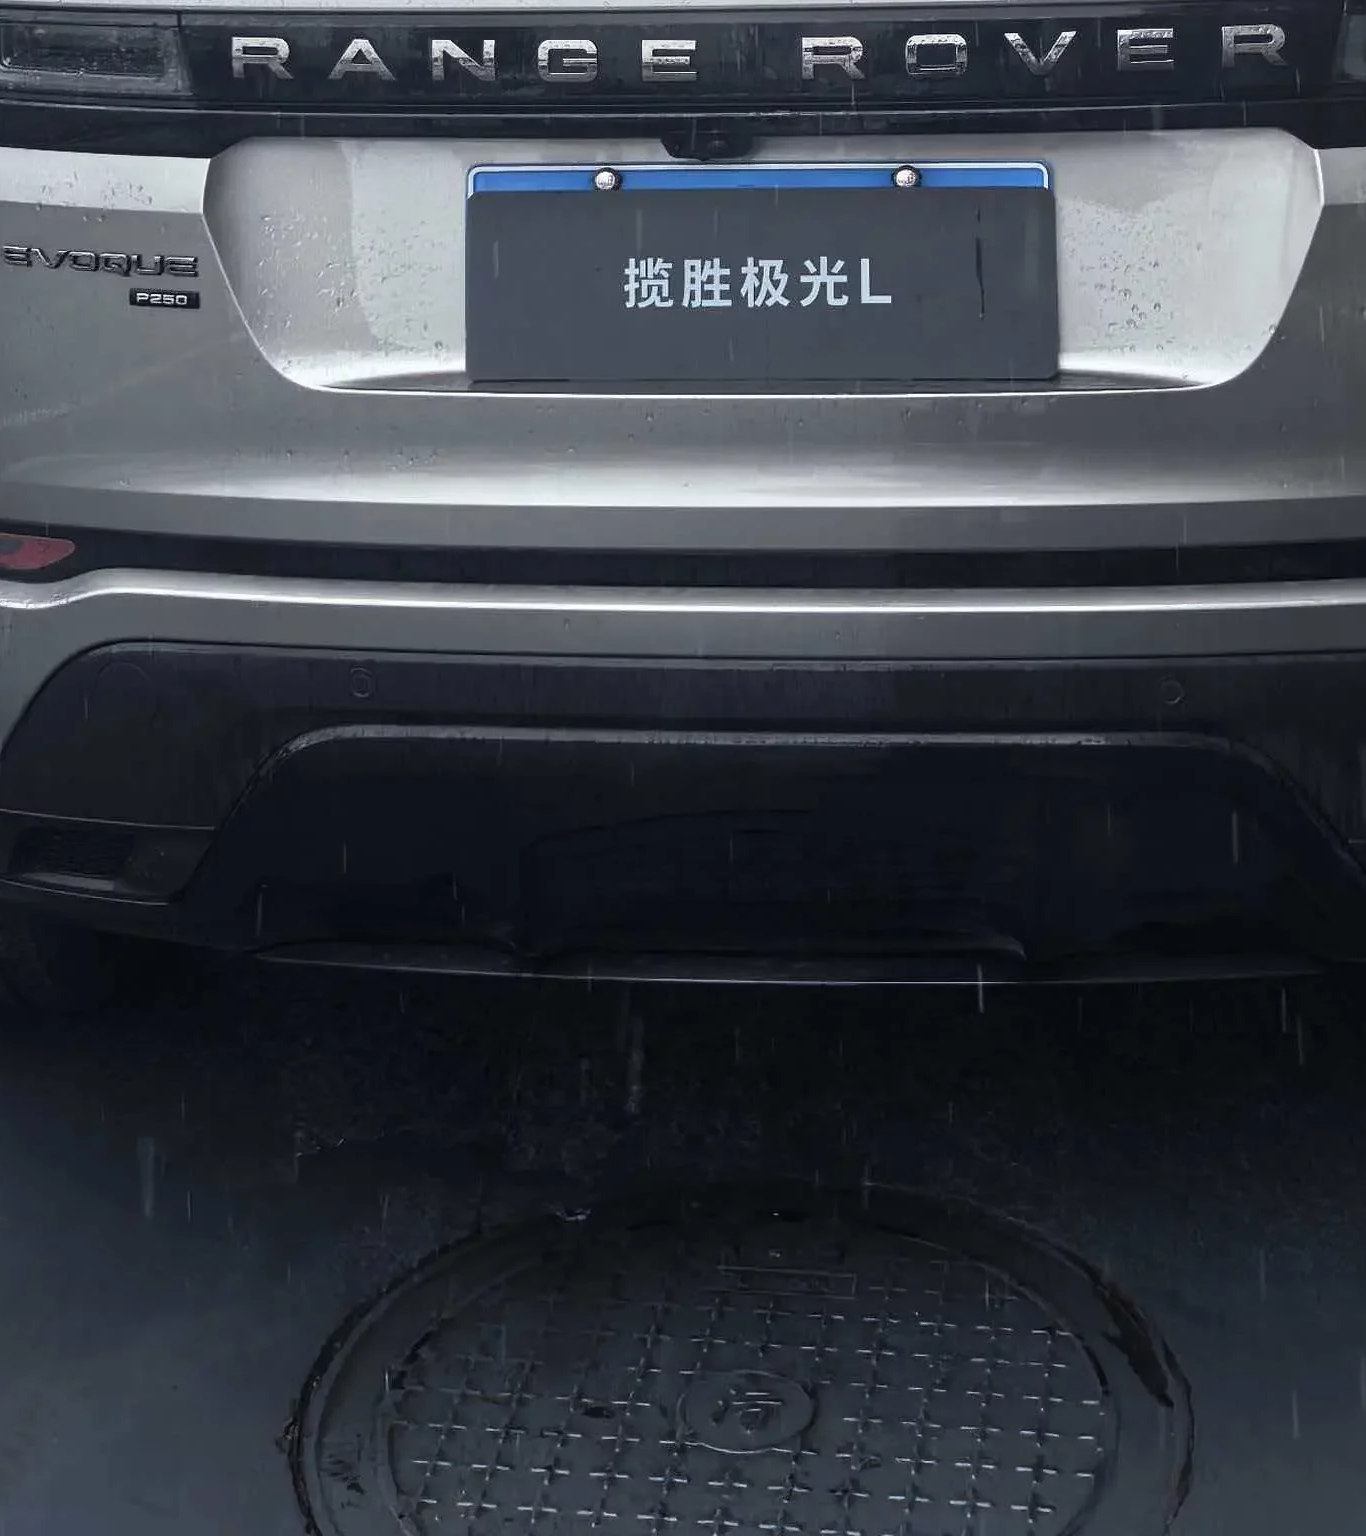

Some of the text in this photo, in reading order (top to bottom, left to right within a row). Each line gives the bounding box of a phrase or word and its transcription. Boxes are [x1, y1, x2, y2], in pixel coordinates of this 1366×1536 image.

[231, 24, 1287, 82] RANGE ROVER
[136, 292, 188, 306] P250
[624, 257, 892, 309] 揽胜极光L
